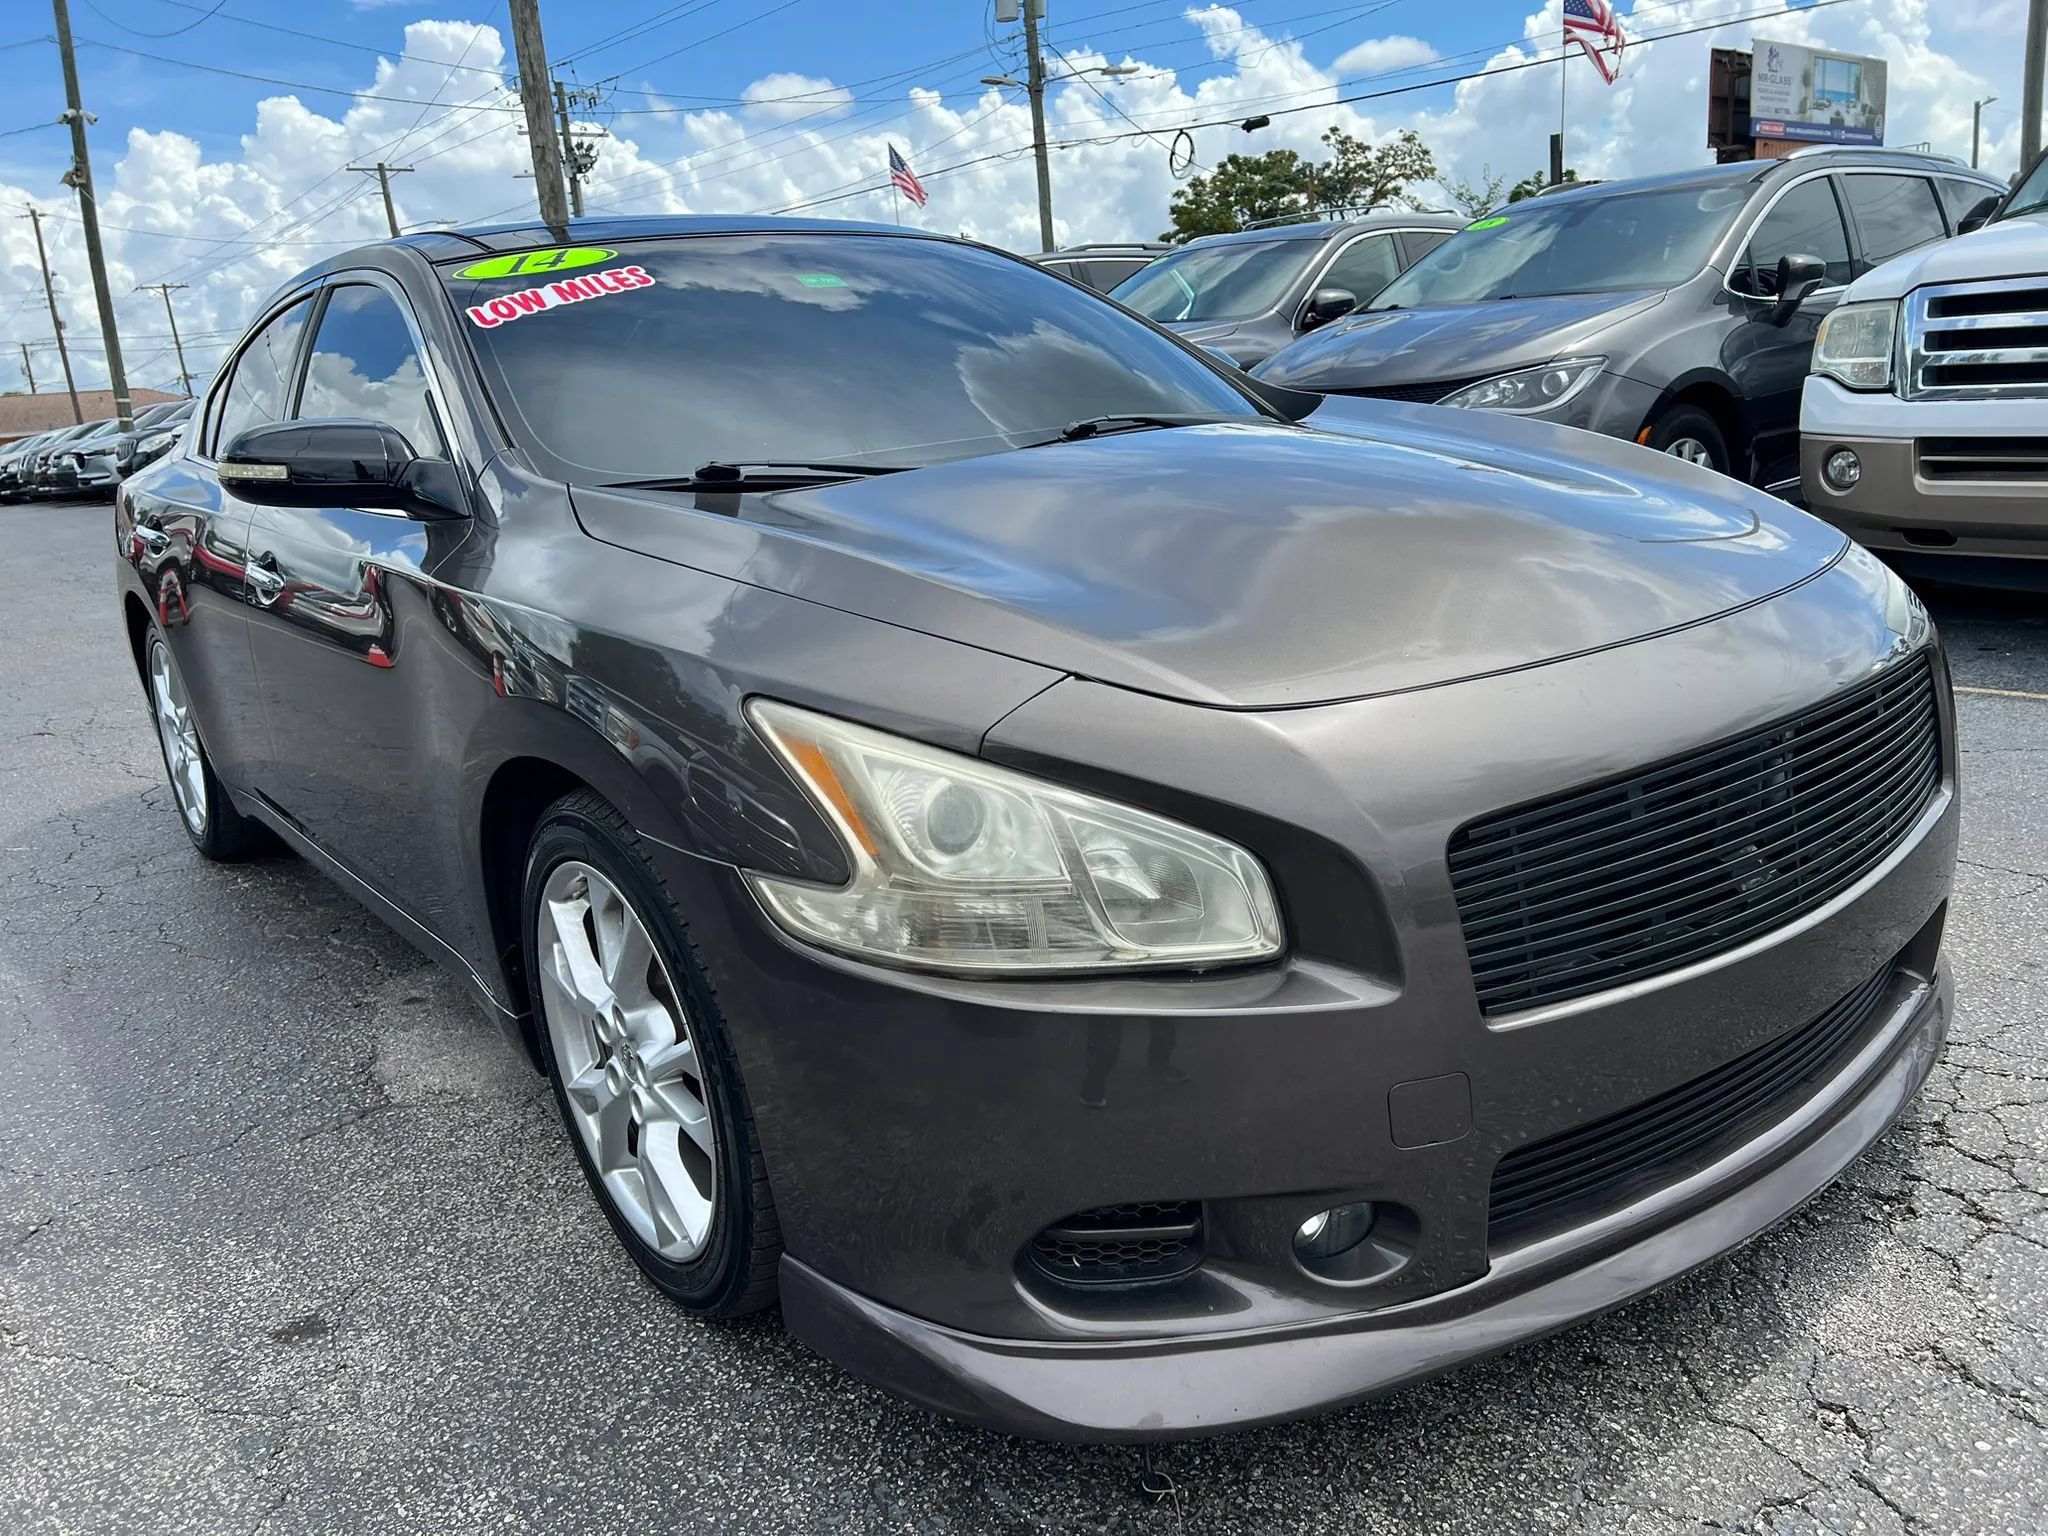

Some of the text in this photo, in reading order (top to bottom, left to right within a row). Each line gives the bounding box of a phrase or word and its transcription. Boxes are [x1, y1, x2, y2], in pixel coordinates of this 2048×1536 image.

[506, 249, 569, 275] 14
[471, 267, 652, 326] LOW MILES
